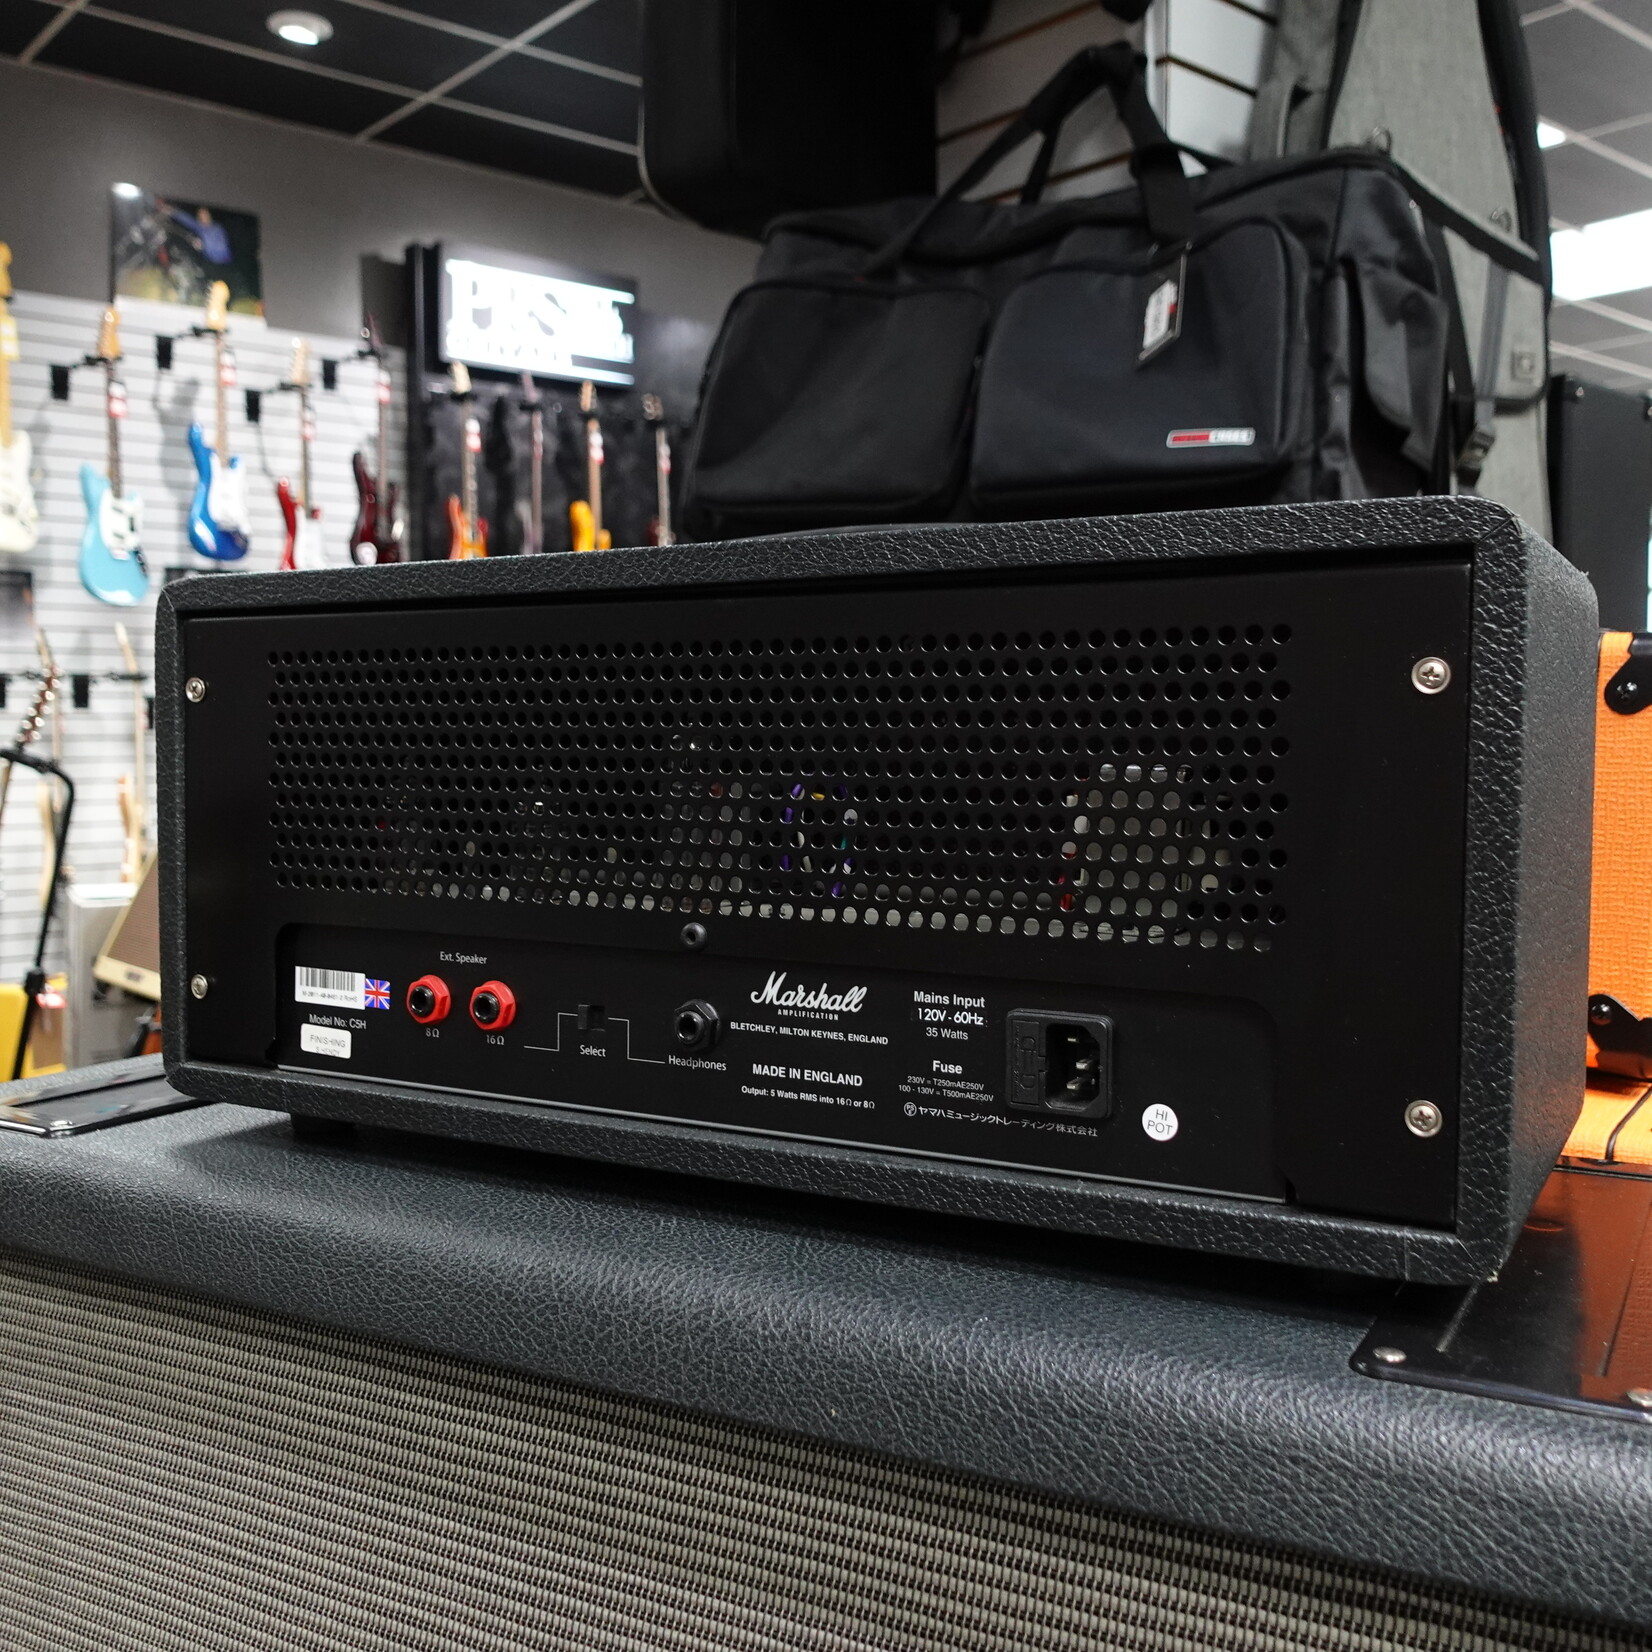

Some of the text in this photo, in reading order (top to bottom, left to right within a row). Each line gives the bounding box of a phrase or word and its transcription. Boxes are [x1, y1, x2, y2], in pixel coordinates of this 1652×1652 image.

[439, 951, 488, 965] Ext. Speaker
[750, 970, 868, 1013] Marshall
[913, 990, 985, 1009] Mains Input
[309, 1013, 367, 1030] Model No: C5H
[777, 1009, 839, 1021] AMPLIFICATION
[730, 1021, 889, 1046] BLETCHLEY, MILTON KEYNES, ENGLAND
[925, 1027, 969, 1041] 35 Watts
[579, 1045, 606, 1058] Select
[668, 1054, 727, 1072] Headphones
[932, 1060, 963, 1075] Fuse
[752, 1063, 863, 1087] MADE IN ENGLAND
[907, 1075, 925, 1084] 230V
[741, 1085, 769, 1096] Output:
[770, 1089, 776, 1097] 5
[777, 1089, 799, 1100] Watts
[799, 1092, 818, 1102] RMS
[819, 1095, 834, 1104] into
[853, 1099, 862, 1107] or
[898, 1084, 911, 1093] 100
[917, 1086, 935, 1095] 130V
[918, 1105, 1099, 1137] ヤマハミュージックトレーディング株式会社
[1155, 1108, 1168, 1120] HI
[1146, 1120, 1174, 1135] POT
